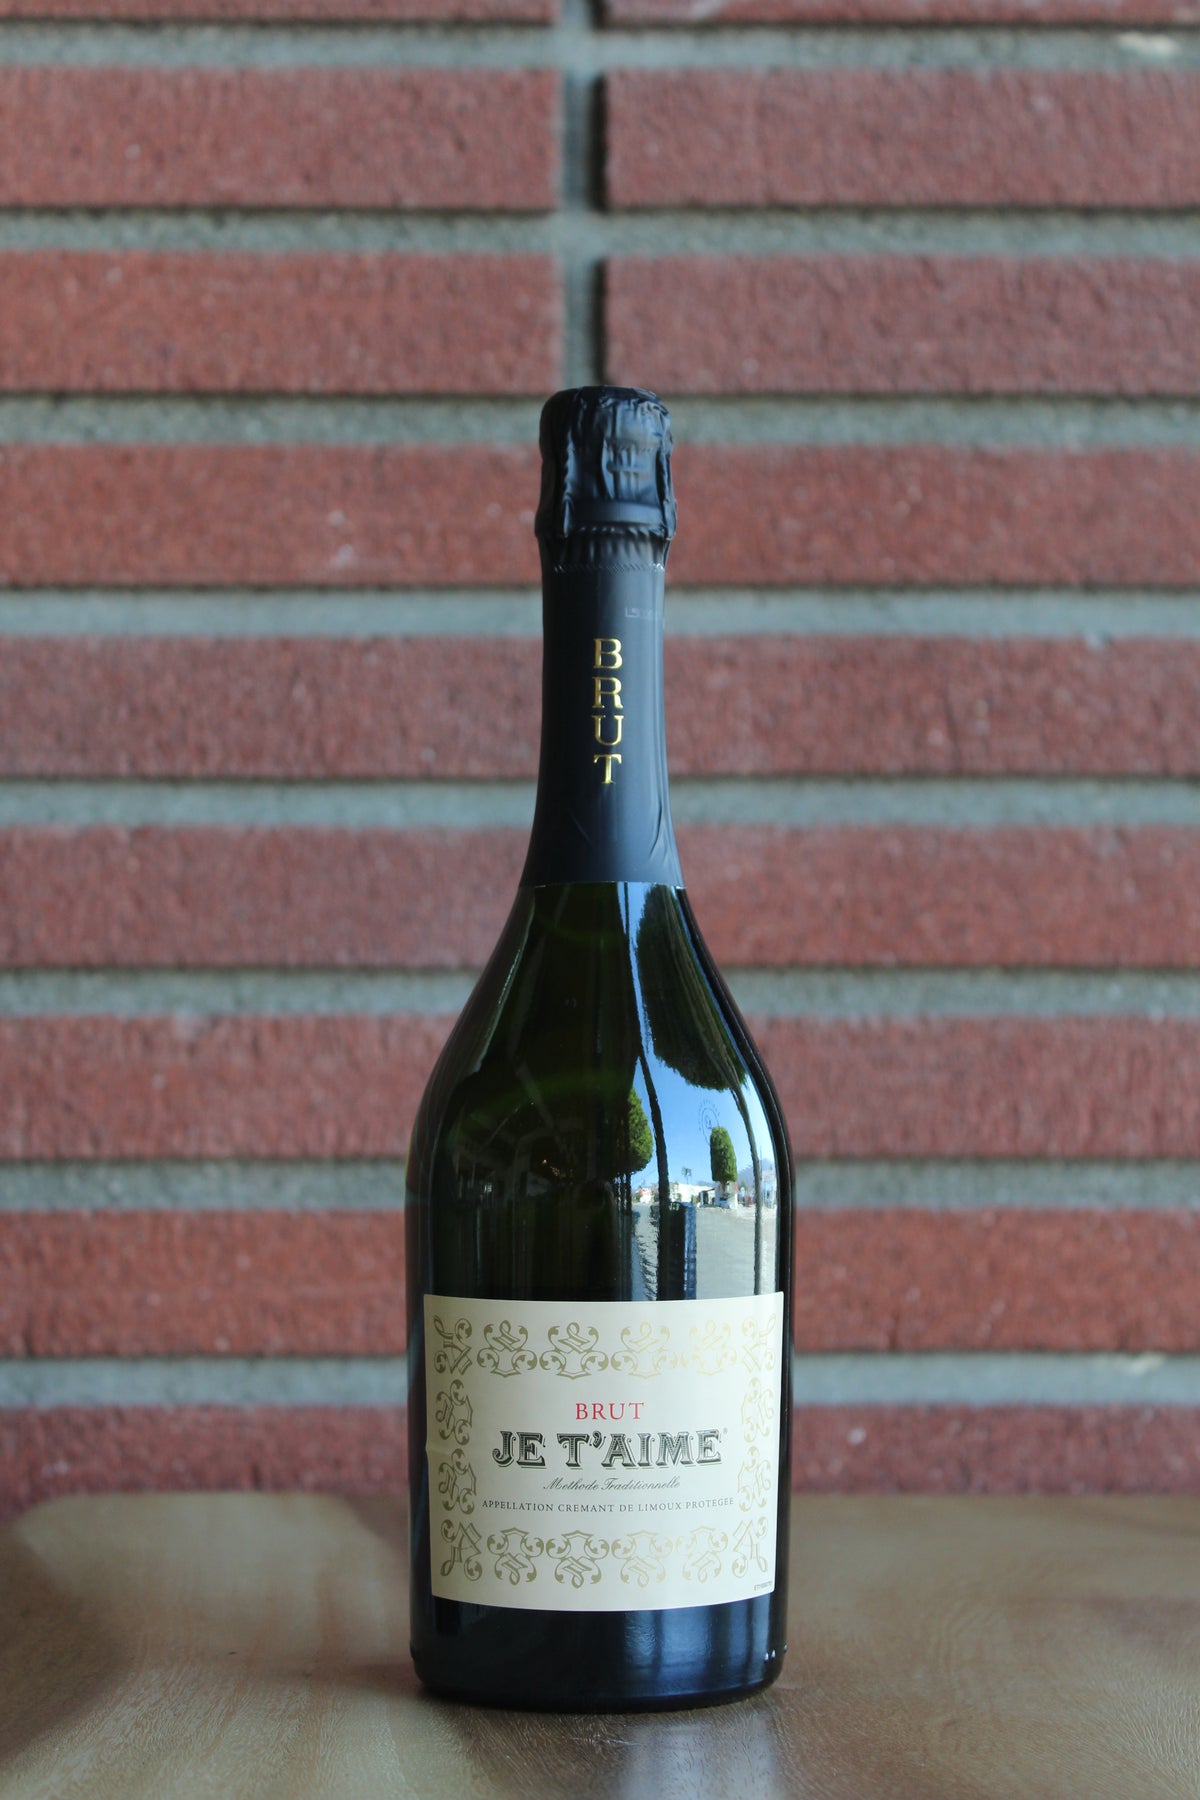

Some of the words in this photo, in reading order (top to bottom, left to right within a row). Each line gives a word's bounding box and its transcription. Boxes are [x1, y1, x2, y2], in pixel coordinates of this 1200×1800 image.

[592, 637, 624, 785] BRUT
[575, 1402, 644, 1420] BRUT
[492, 1430, 547, 1469] JE
[600, 1476, 681, 1491] Traditionnelle
[482, 1500, 554, 1512] APPELLATION
[558, 1504, 614, 1513] CREMANT
[619, 1504, 634, 1512] DE
[638, 1502, 682, 1512] LIMOUX
[685, 1497, 735, 1510] PROTEGEE
